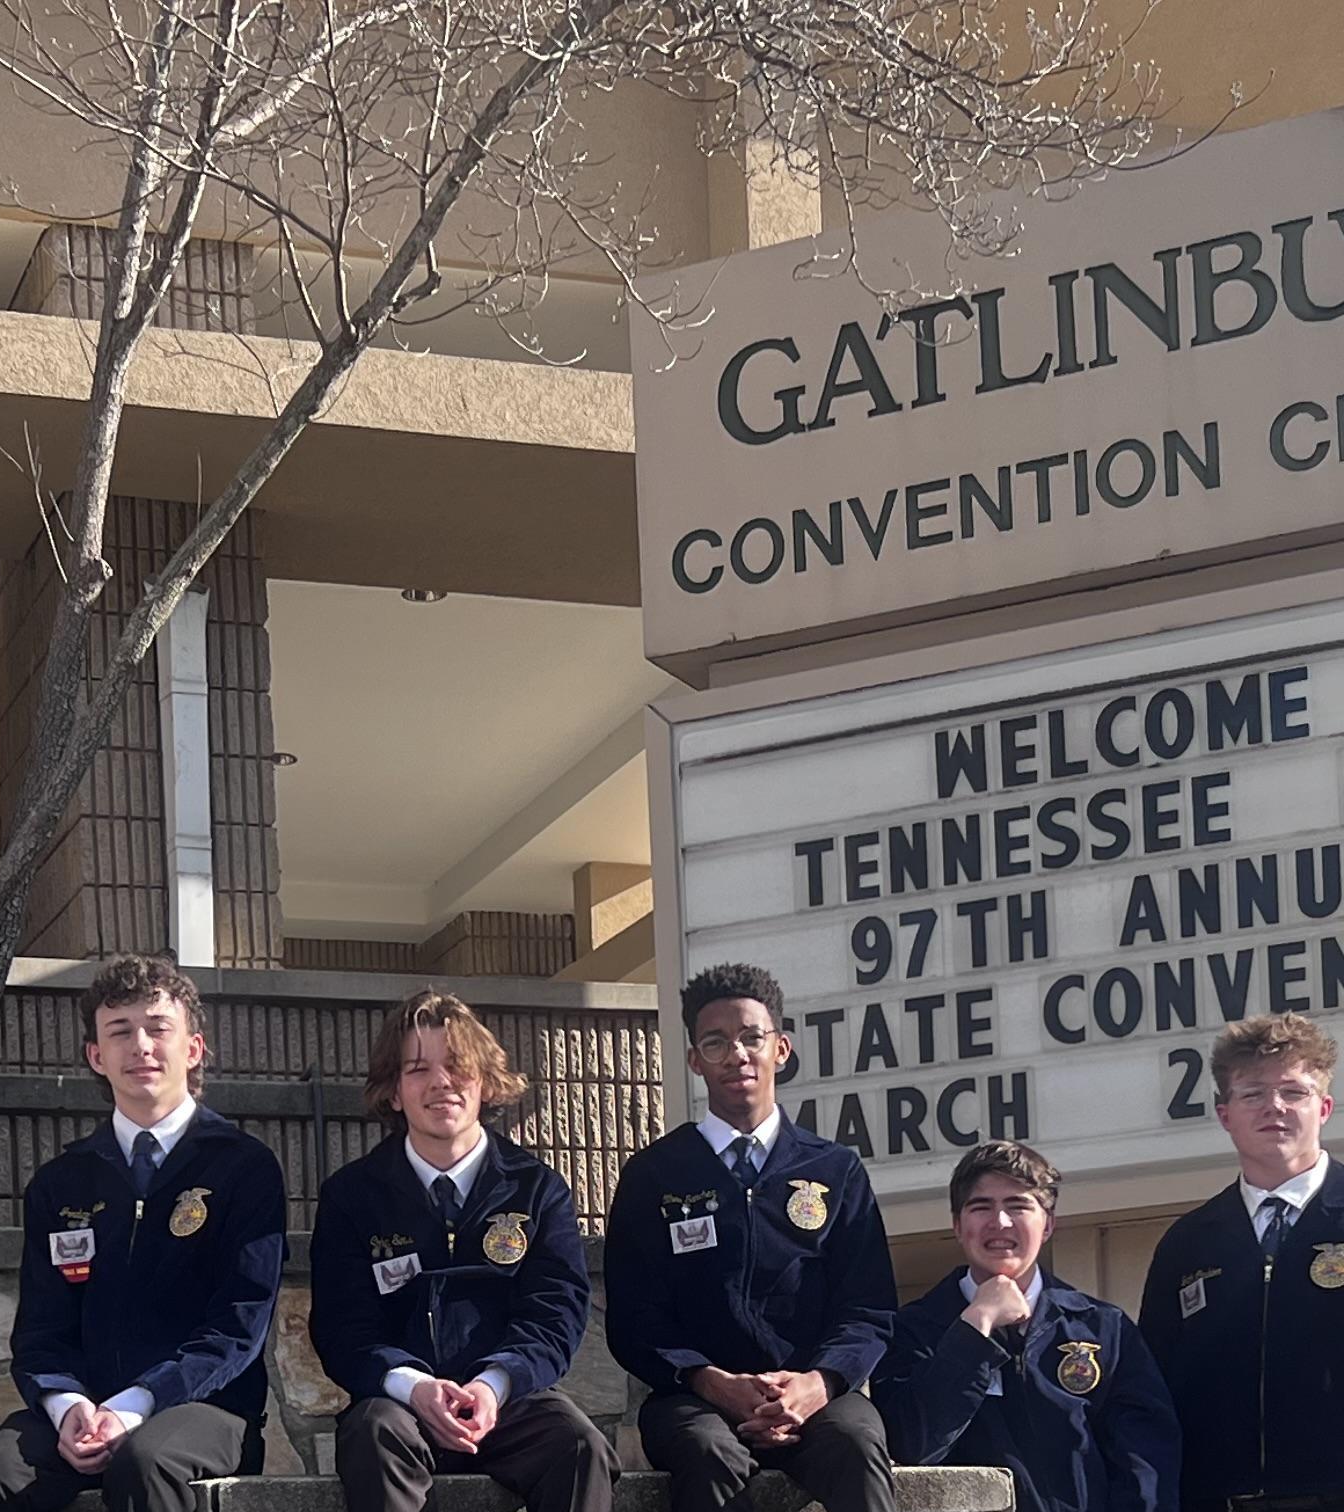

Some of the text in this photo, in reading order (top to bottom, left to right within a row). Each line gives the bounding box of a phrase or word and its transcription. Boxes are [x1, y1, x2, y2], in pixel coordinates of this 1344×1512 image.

[671, 421, 1221, 594] CONVENTION
[935, 666, 1309, 799] WELCOME
[794, 771, 1231, 907] TENNESSEE
[851, 889, 1049, 986] 97TH
